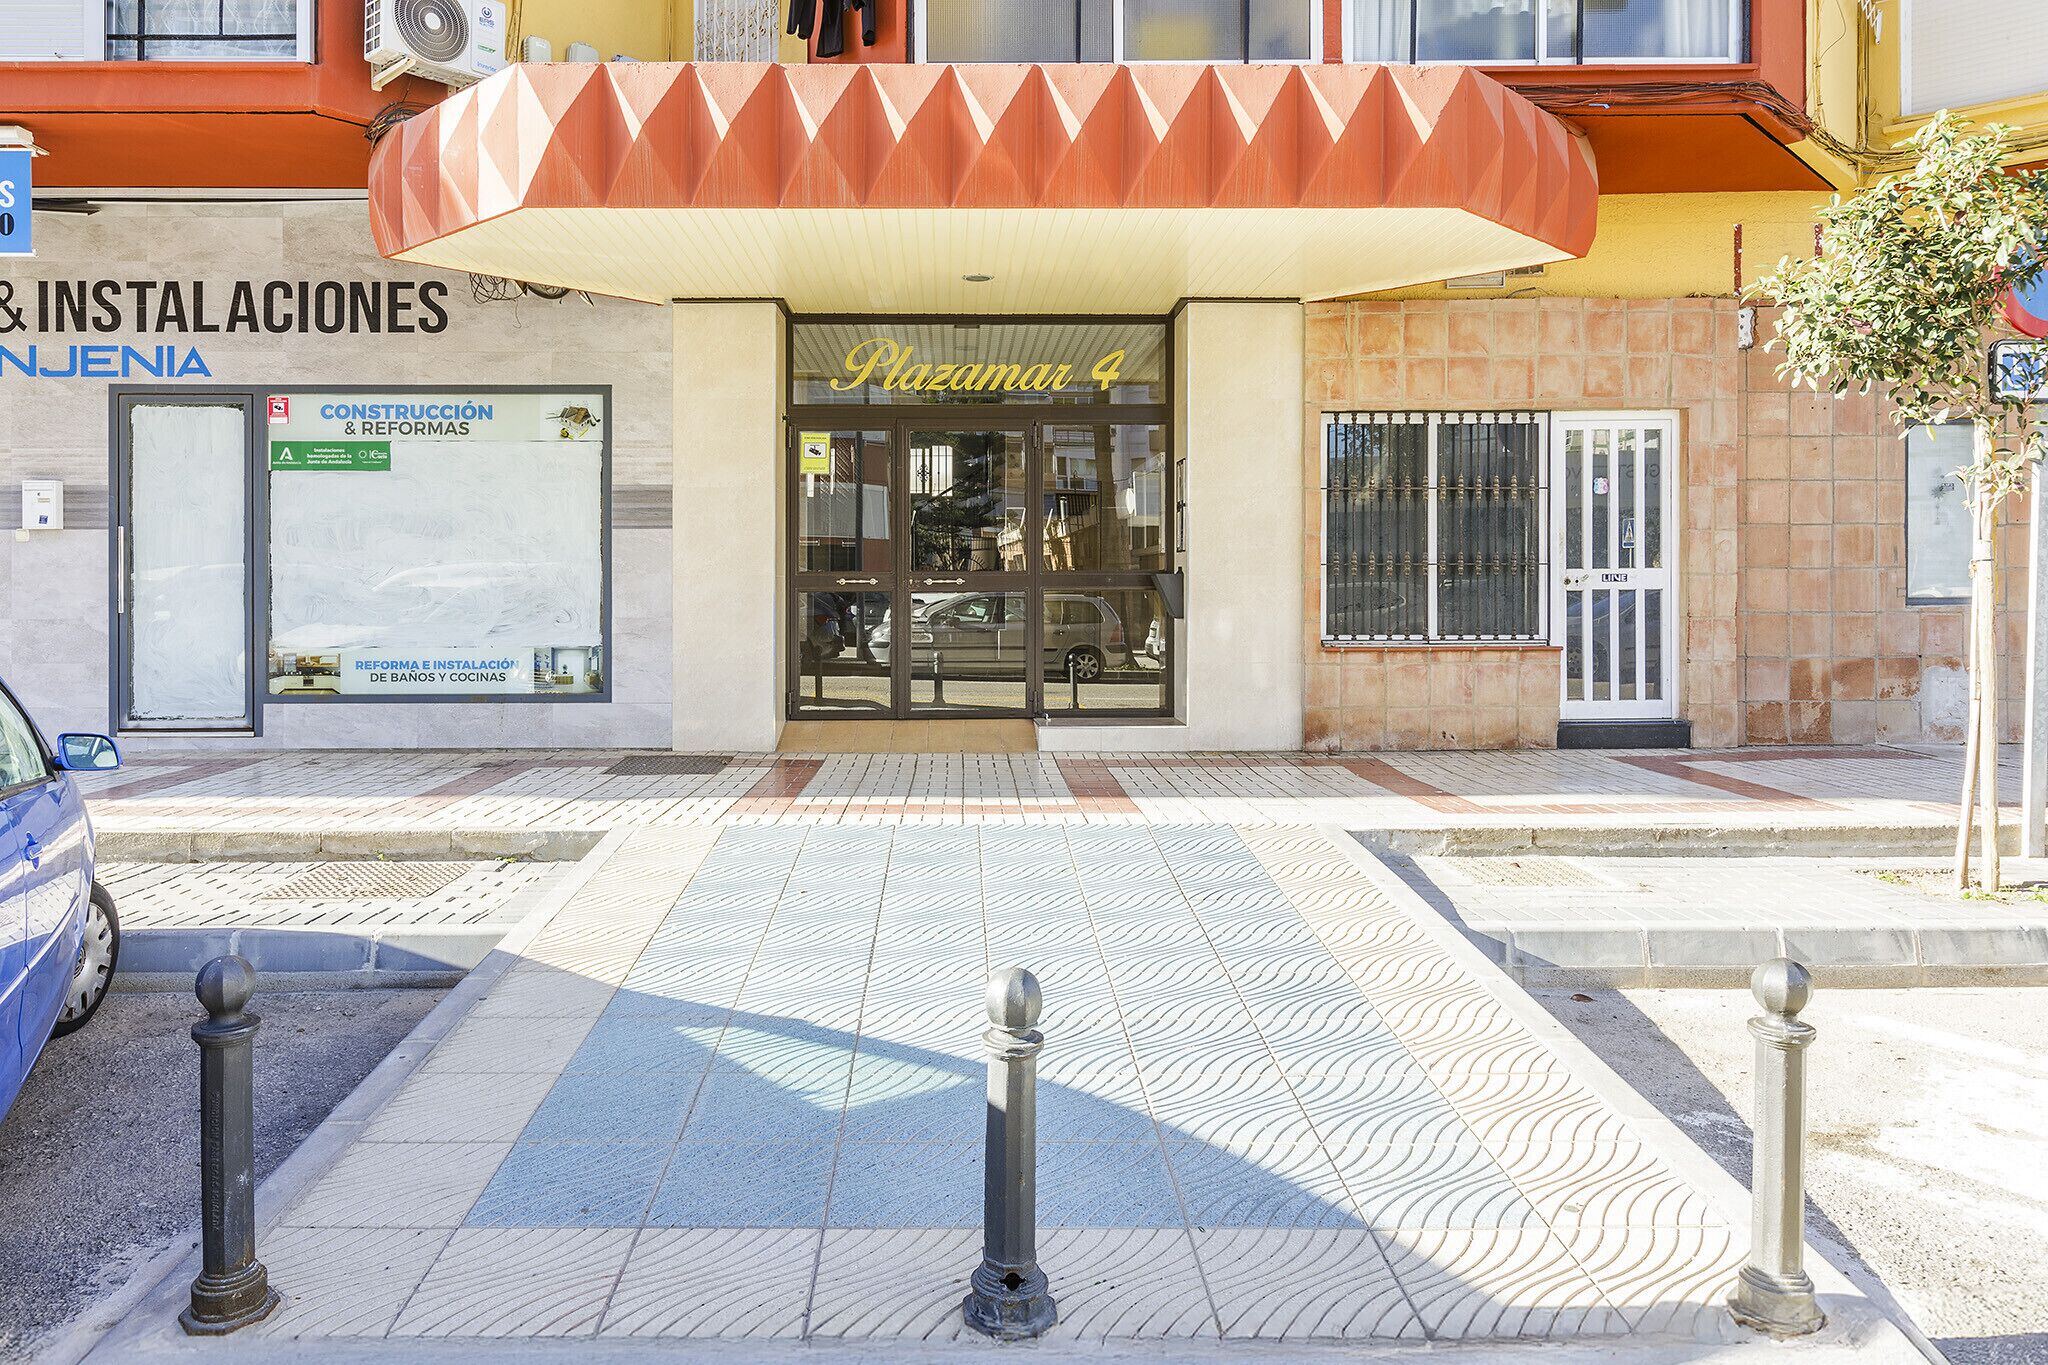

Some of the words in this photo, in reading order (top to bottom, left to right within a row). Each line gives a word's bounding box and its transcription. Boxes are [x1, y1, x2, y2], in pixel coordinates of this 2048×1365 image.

[38, 280, 448, 334] INSTALACIONES
[830, 338, 1073, 392] Plazamar
[1091, 349, 1126, 391] 4
[320, 401, 493, 420] CONSTRUCCIÓN
[344, 421, 356, 436] &
[362, 421, 470, 436] REFORMAS
[355, 660, 419, 670] REFORMA
[422, 661, 430, 670] E
[370, 673, 387, 682] DE
[391, 670, 435, 682] BAÑOS
[438, 673, 447, 682] Y
[449, 673, 506, 682] COCINAS
